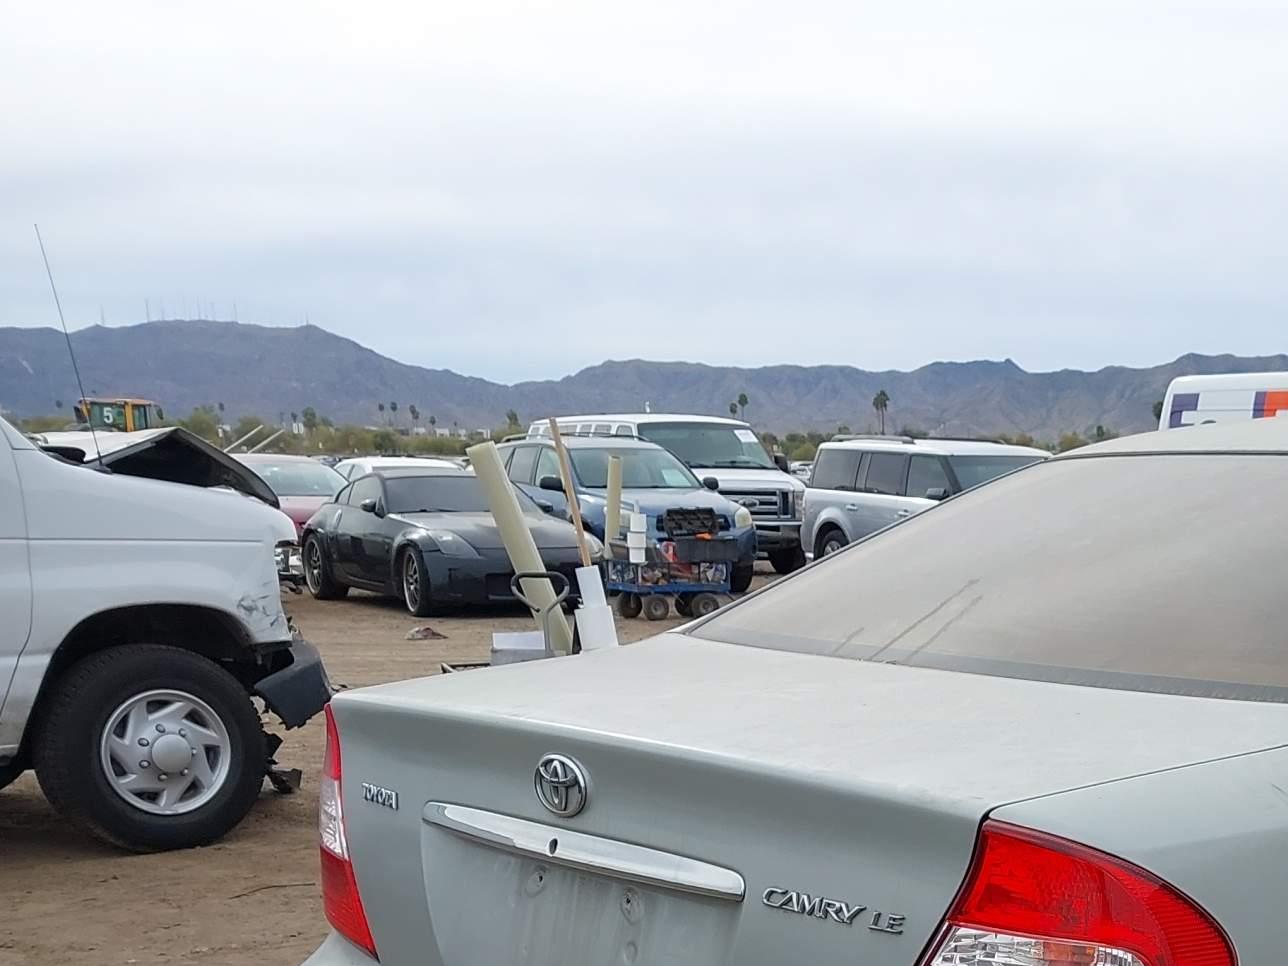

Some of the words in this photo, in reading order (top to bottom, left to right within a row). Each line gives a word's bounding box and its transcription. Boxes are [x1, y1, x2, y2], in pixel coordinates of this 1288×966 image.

[103, 406, 114, 424] 5
[361, 782, 399, 811] TOYOTA
[762, 887, 867, 925] CAMRY
[868, 911, 906, 935] LE
